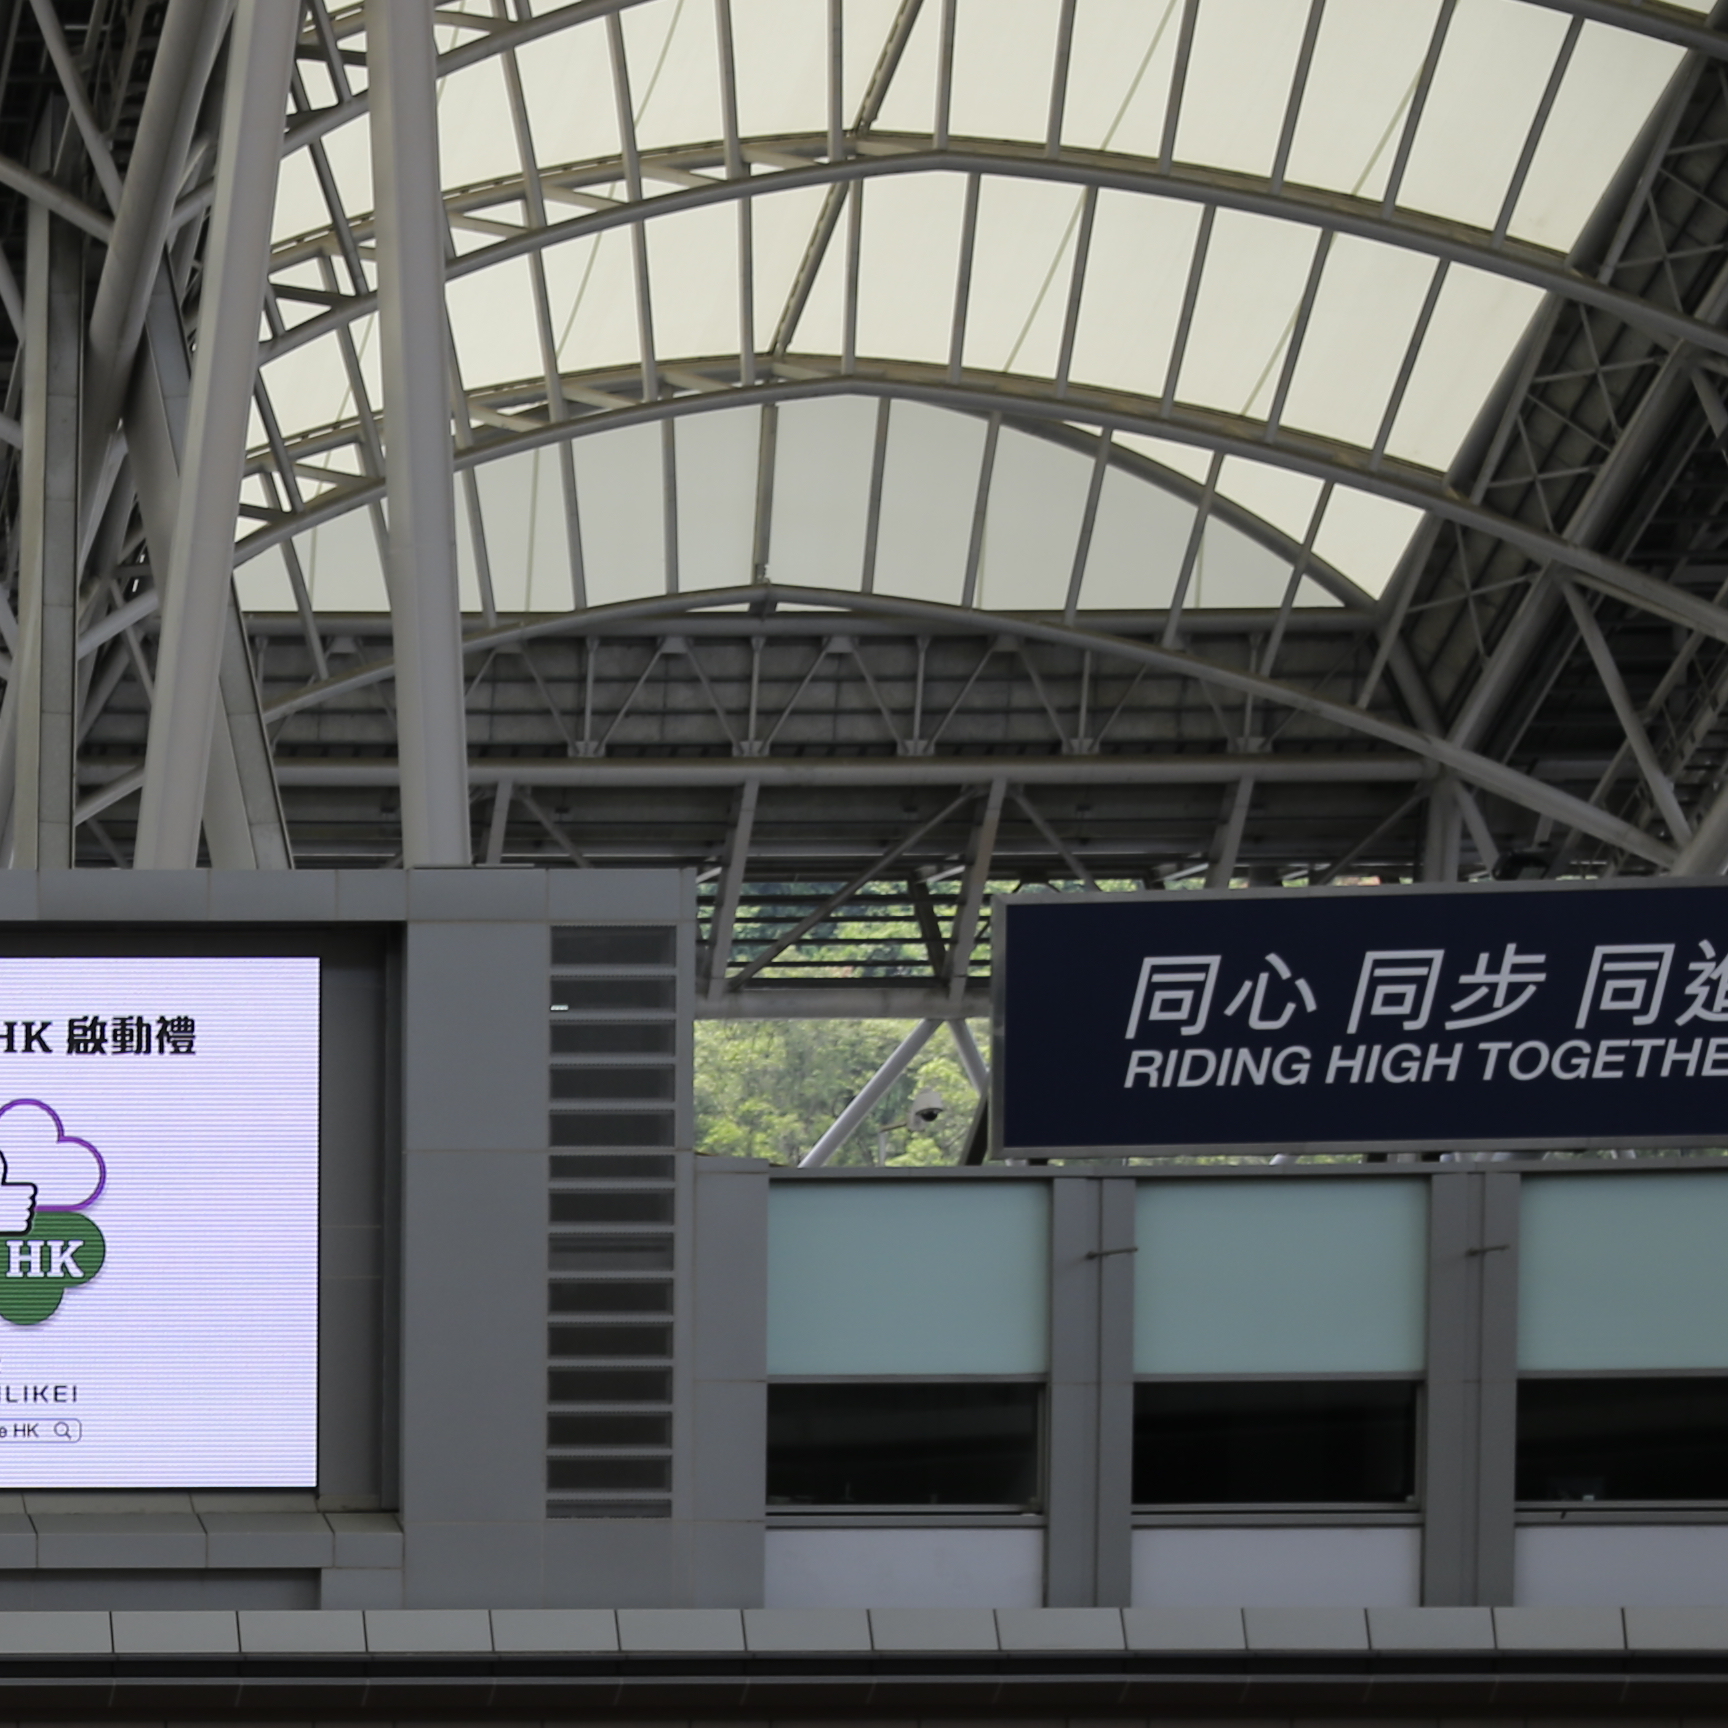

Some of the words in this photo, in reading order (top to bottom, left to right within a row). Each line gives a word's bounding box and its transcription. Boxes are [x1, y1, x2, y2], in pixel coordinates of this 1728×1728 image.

[1124, 952, 1317, 1040] 同心
[1346, 942, 1547, 1035] 同步
[1123, 1045, 1312, 1089] RIDING
[1325, 1042, 1464, 1084] HIGH
[6, 1240, 84, 1277] HK
[13, 1424, 39, 1438] HK
